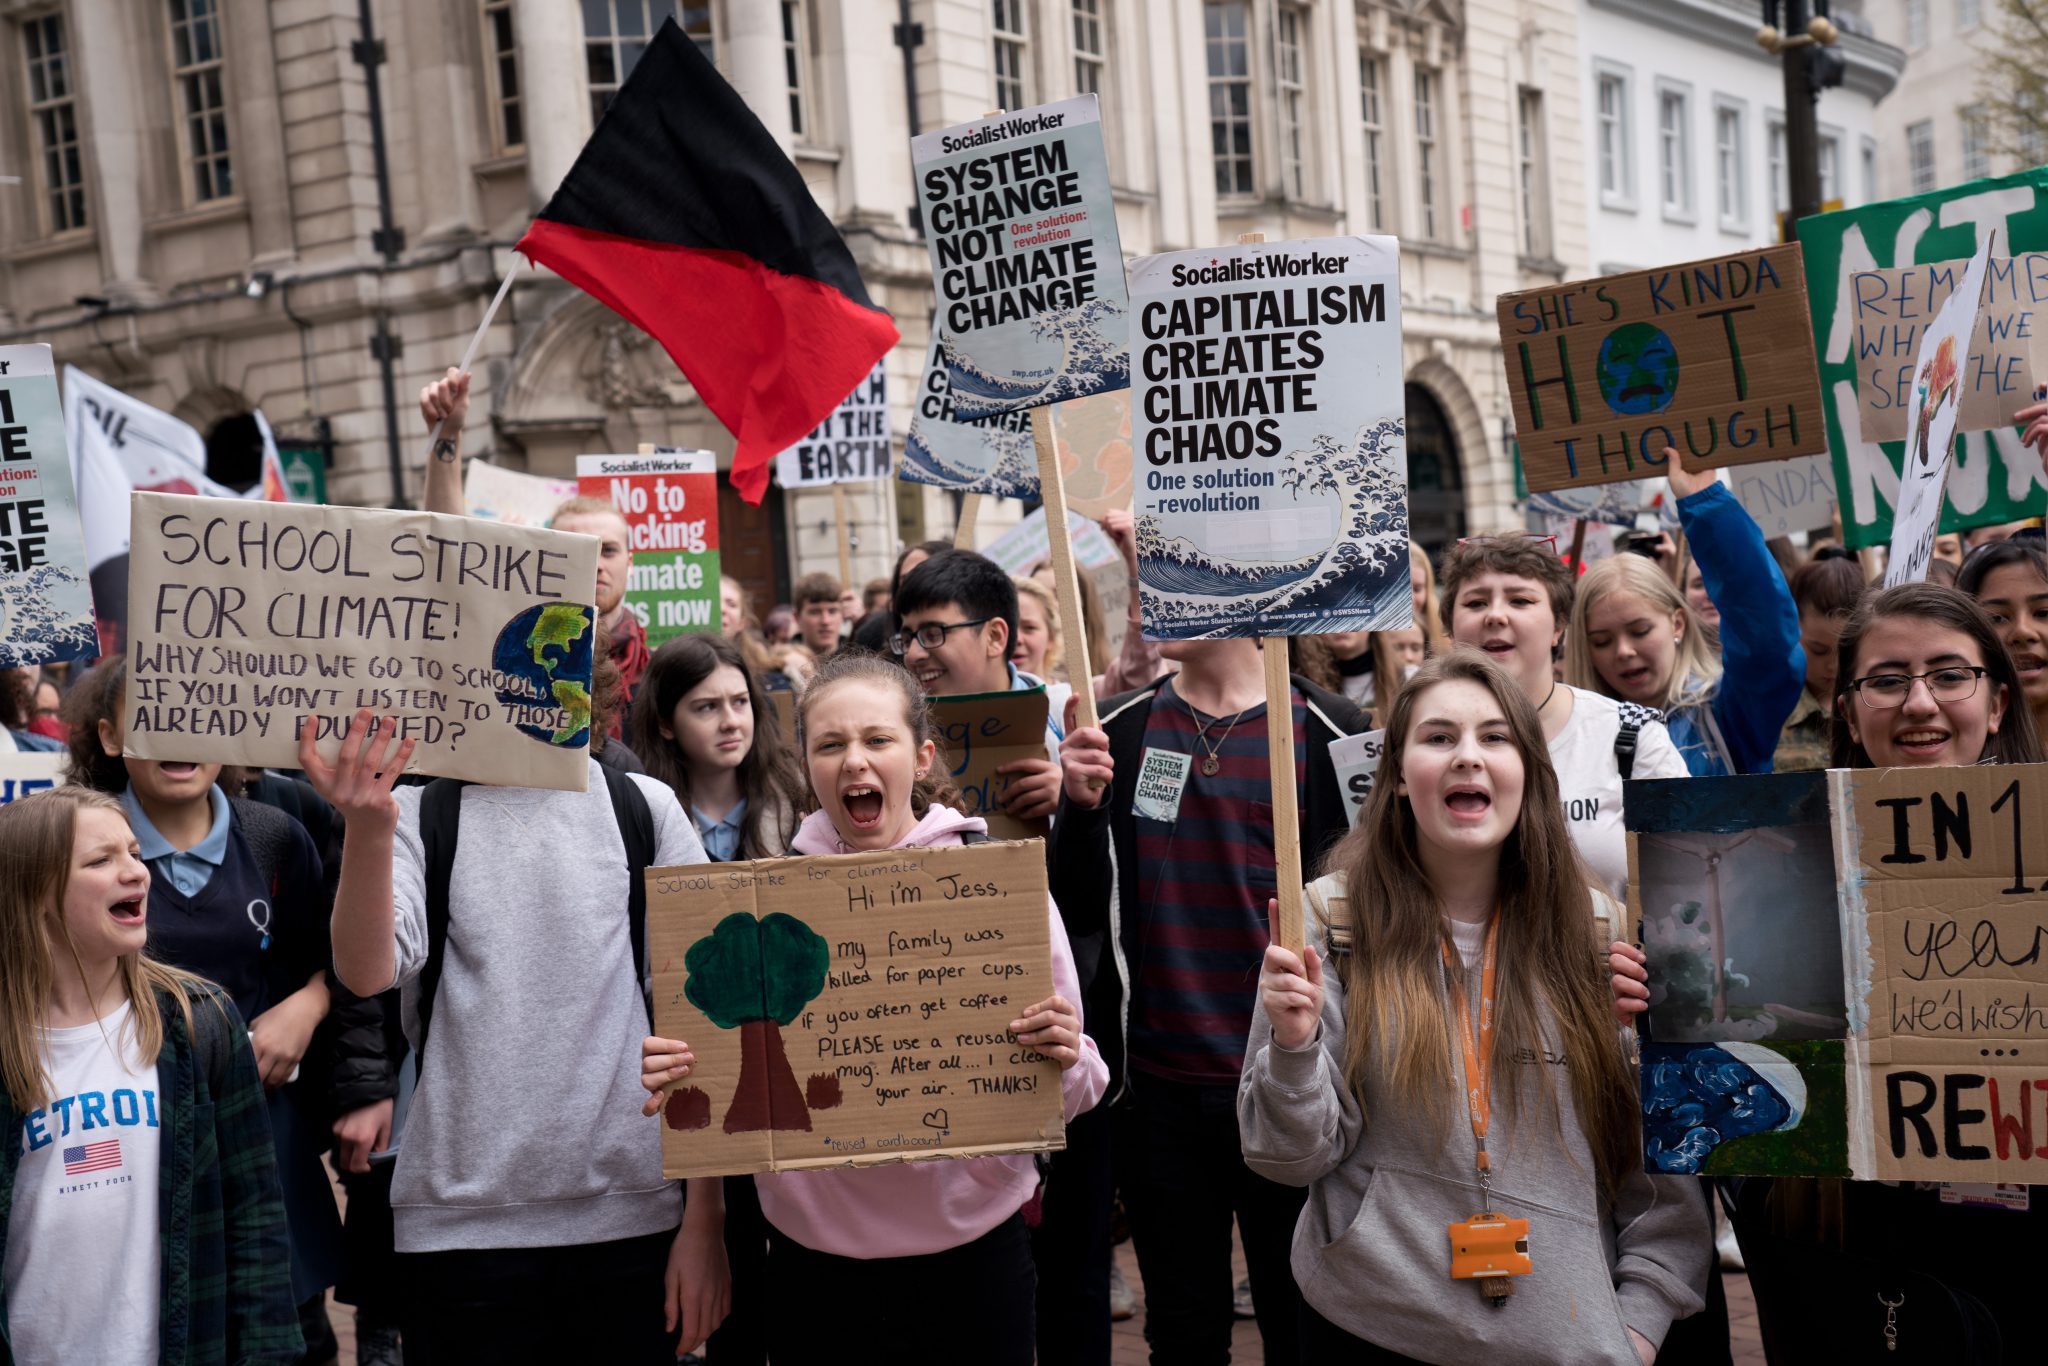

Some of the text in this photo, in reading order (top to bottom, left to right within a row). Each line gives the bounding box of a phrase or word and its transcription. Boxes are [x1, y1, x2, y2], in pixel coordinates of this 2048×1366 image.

[942, 112, 1065, 154] Socialist Worker
[925, 139, 1069, 202] SYSTEM
[931, 171, 1082, 235] CHANGE
[1011, 210, 1088, 236] One solution:
[936, 223, 1006, 269] NOT
[1013, 227, 1071, 249] revolution
[942, 239, 1098, 301] CLIMATE
[1172, 251, 1349, 288] Socialist Worker
[947, 273, 1098, 334] CHANGE
[1141, 283, 1386, 341] CAPITALISM
[1514, 255, 1782, 336] SHE'S KINDA
[1987, 312, 2034, 344] WE
[1012, 366, 1055, 380] swp.org.uk
[1142, 329, 1325, 383] CREATES
[1144, 373, 1318, 424] CLIMATE
[839, 410, 884, 438] THE
[1145, 418, 1283, 466] CHAOS
[1553, 403, 1800, 479] THOUGH
[600, 459, 692, 474] Socialist Worker
[798, 440, 890, 481] EARTH
[1146, 467, 1275, 490] One solution
[610, 477, 686, 514] No to
[160, 514, 568, 598] SCHOOL STRIKE
[155, 583, 461, 641] FOR CLIMATE!
[657, 598, 712, 628] now
[135, 640, 204, 674] WHY
[208, 645, 308, 678] SHOULD
[316, 652, 359, 679] WE
[368, 655, 403, 679] GO
[409, 655, 444, 681] TO
[133, 704, 271, 738] ALREADY
[136, 678, 172, 704] IF
[178, 680, 239, 706] YOU
[356, 688, 448, 712] LISTEN
[458, 699, 491, 721] TO
[501, 702, 571, 730] THOSE
[1142, 772, 1161, 783] NOT
[1144, 765, 1184, 780] CHANGE
[1145, 756, 1184, 771] SYSTEM
[1137, 788, 1178, 803] CHANGE
[1139, 780, 1181, 796] CLIMATE
[1875, 790, 1972, 864] IN
[655, 860, 925, 895] School Strike for climate!
[847, 873, 1008, 913] Hi i'm Jess,
[837, 927, 1005, 970] my family was
[828, 963, 1030, 990] killed for paper cups.
[801, 994, 1008, 1035] if you often get coffee
[1892, 989, 1963, 1034] We'd
[818, 1030, 1021, 1058] PLEASE use a reusab
[835, 1064, 880, 1088] mug.
[890, 1056, 932, 1075] After
[876, 1074, 1038, 1107] your air. THANKS!
[20, 1087, 160, 1157] ETROI
[59, 1174, 134, 1195] NINETY FOUR
